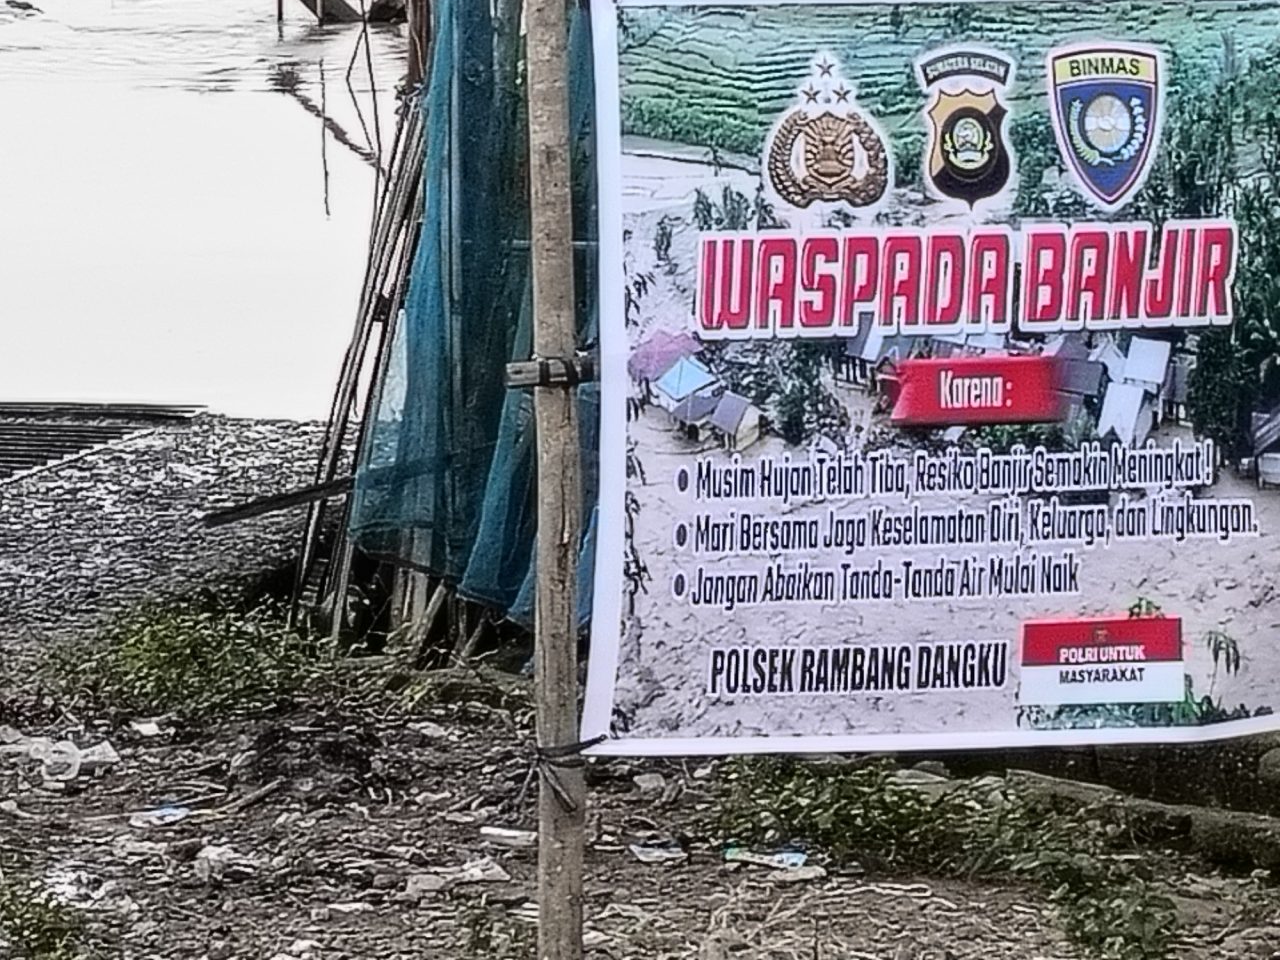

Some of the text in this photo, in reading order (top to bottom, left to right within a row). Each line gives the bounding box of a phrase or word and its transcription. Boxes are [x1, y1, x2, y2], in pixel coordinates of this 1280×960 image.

[1069, 57, 1141, 77] BINMAS
[699, 227, 1234, 331] WASPADA BANJIR
[696, 458, 755, 499] Musim
[761, 457, 812, 504] Hujan
[817, 454, 863, 498] Telah
[869, 453, 910, 499] Tiba,
[916, 451, 974, 492] Resiko
[980, 448, 1032, 490] Banjir
[1034, 444, 1108, 487] Semakin
[695, 495, 1259, 554] Mari Bersama Jaga Keselamatan Diri, Keluarga, dan Lingkungan.
[692, 551, 1080, 611] Jangan Abaikan Tanda-Tanda Air Mulai Naik
[710, 642, 1008, 694] POLSEK RAMBANG DANGKU
[1059, 644, 1147, 664] POLRI UNTUK
[1059, 667, 1146, 684] MASYARAKAT
